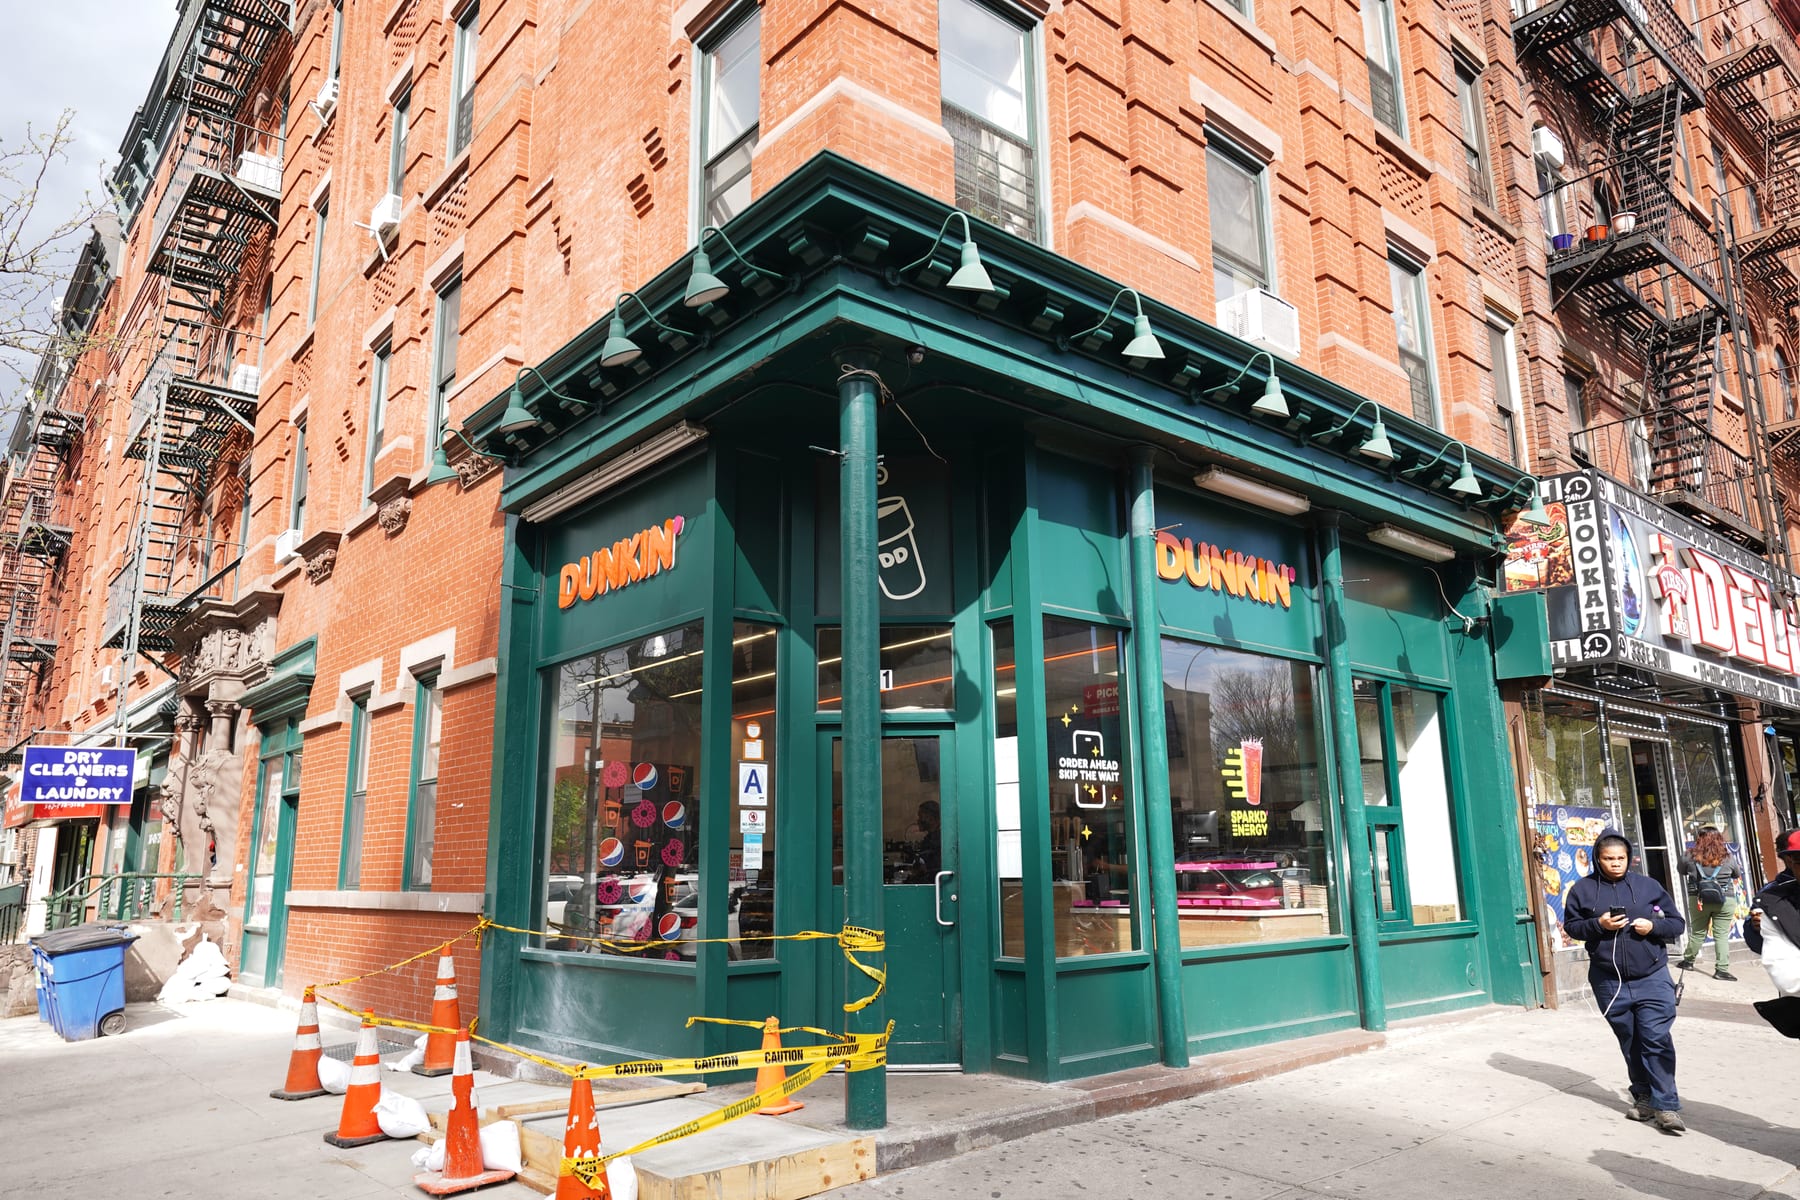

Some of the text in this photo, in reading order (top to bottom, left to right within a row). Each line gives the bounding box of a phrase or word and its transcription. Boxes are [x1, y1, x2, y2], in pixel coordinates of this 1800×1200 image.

[1564, 493, 1581, 503] 24h
[558, 515, 684, 609] DUNKIN'
[879, 547, 908, 568] DD
[1156, 530, 1296, 608] DUNKIN'
[1572, 502, 1607, 631] HOOKAH
[1583, 649, 1601, 659] 24h
[64, 751, 103, 764] DRY
[1059, 757, 1118, 770] ORDER AHEAD
[29, 763, 129, 777] CLEANERS
[1059, 769, 1119, 782] SKIP THE WAIT
[75, 776, 88, 787] &
[744, 769, 762, 793] A
[35, 787, 124, 800] LAUNDRY
[1232, 824, 1268, 837] ENERGY
[615, 1062, 663, 1075] CAUTION
[694, 1055, 739, 1070] CAUTION
[764, 1049, 804, 1064] CAUTION
[826, 1043, 860, 1058] CAUTION
